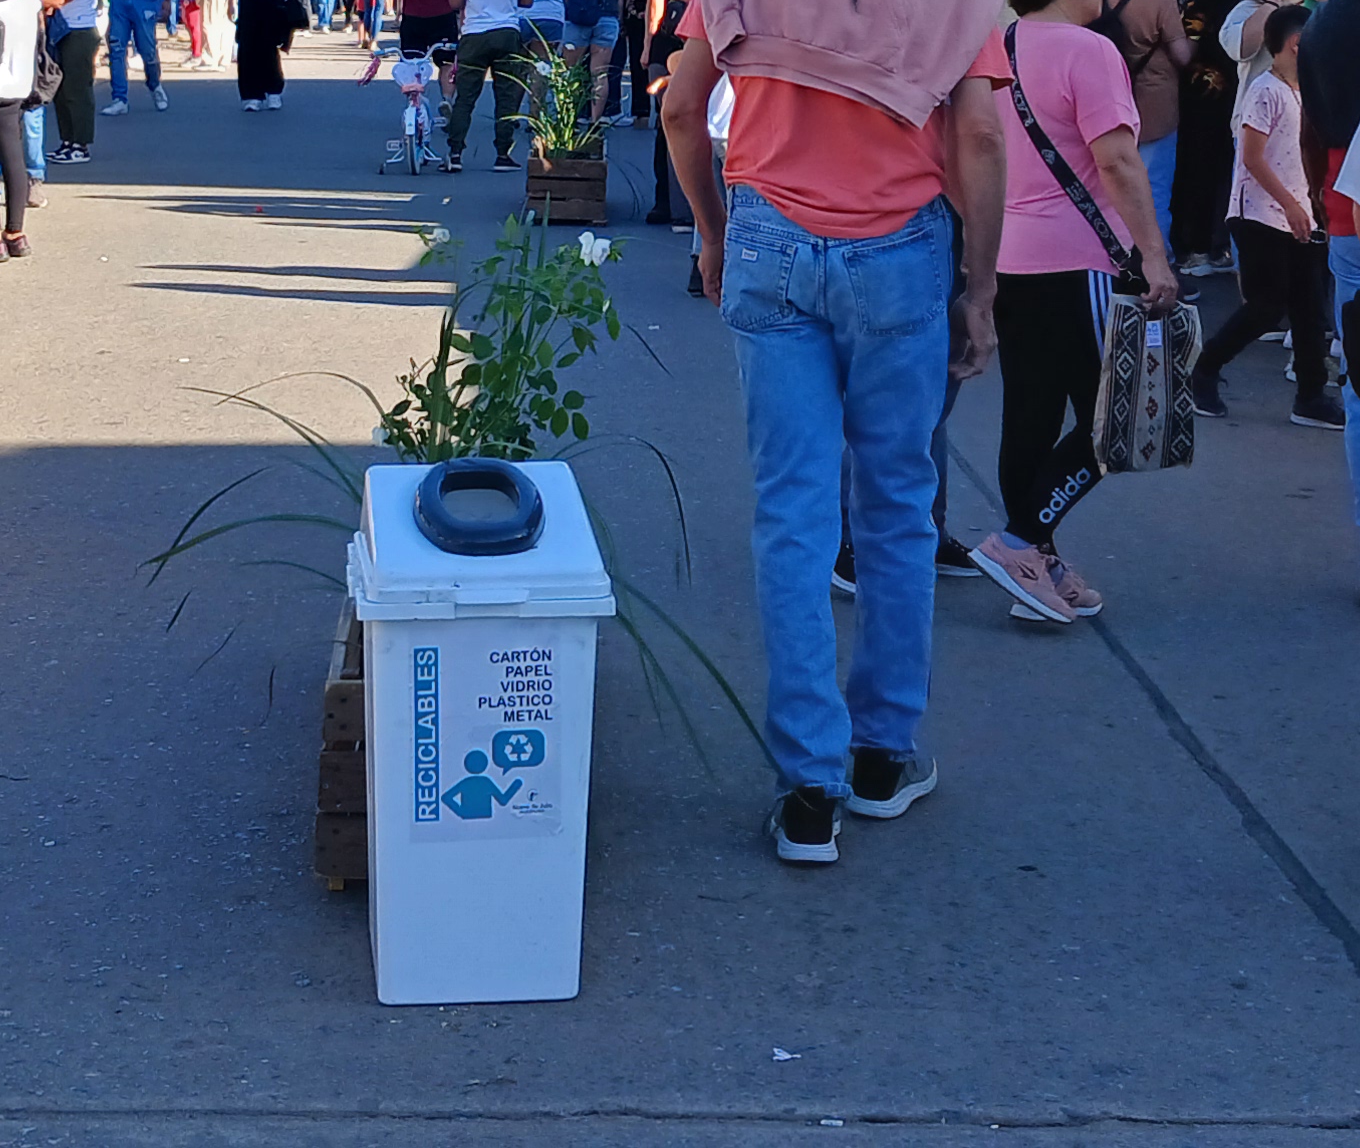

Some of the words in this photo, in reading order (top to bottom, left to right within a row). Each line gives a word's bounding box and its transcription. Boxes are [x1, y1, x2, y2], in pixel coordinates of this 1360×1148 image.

[1038, 467, 1092, 524] adida
[489, 647, 552, 664] CARTÓN
[505, 664, 553, 678] PAPEL
[500, 679, 553, 693] VIDRIO
[503, 709, 553, 723] METAL
[416, 650, 437, 820] RECICLABLES
